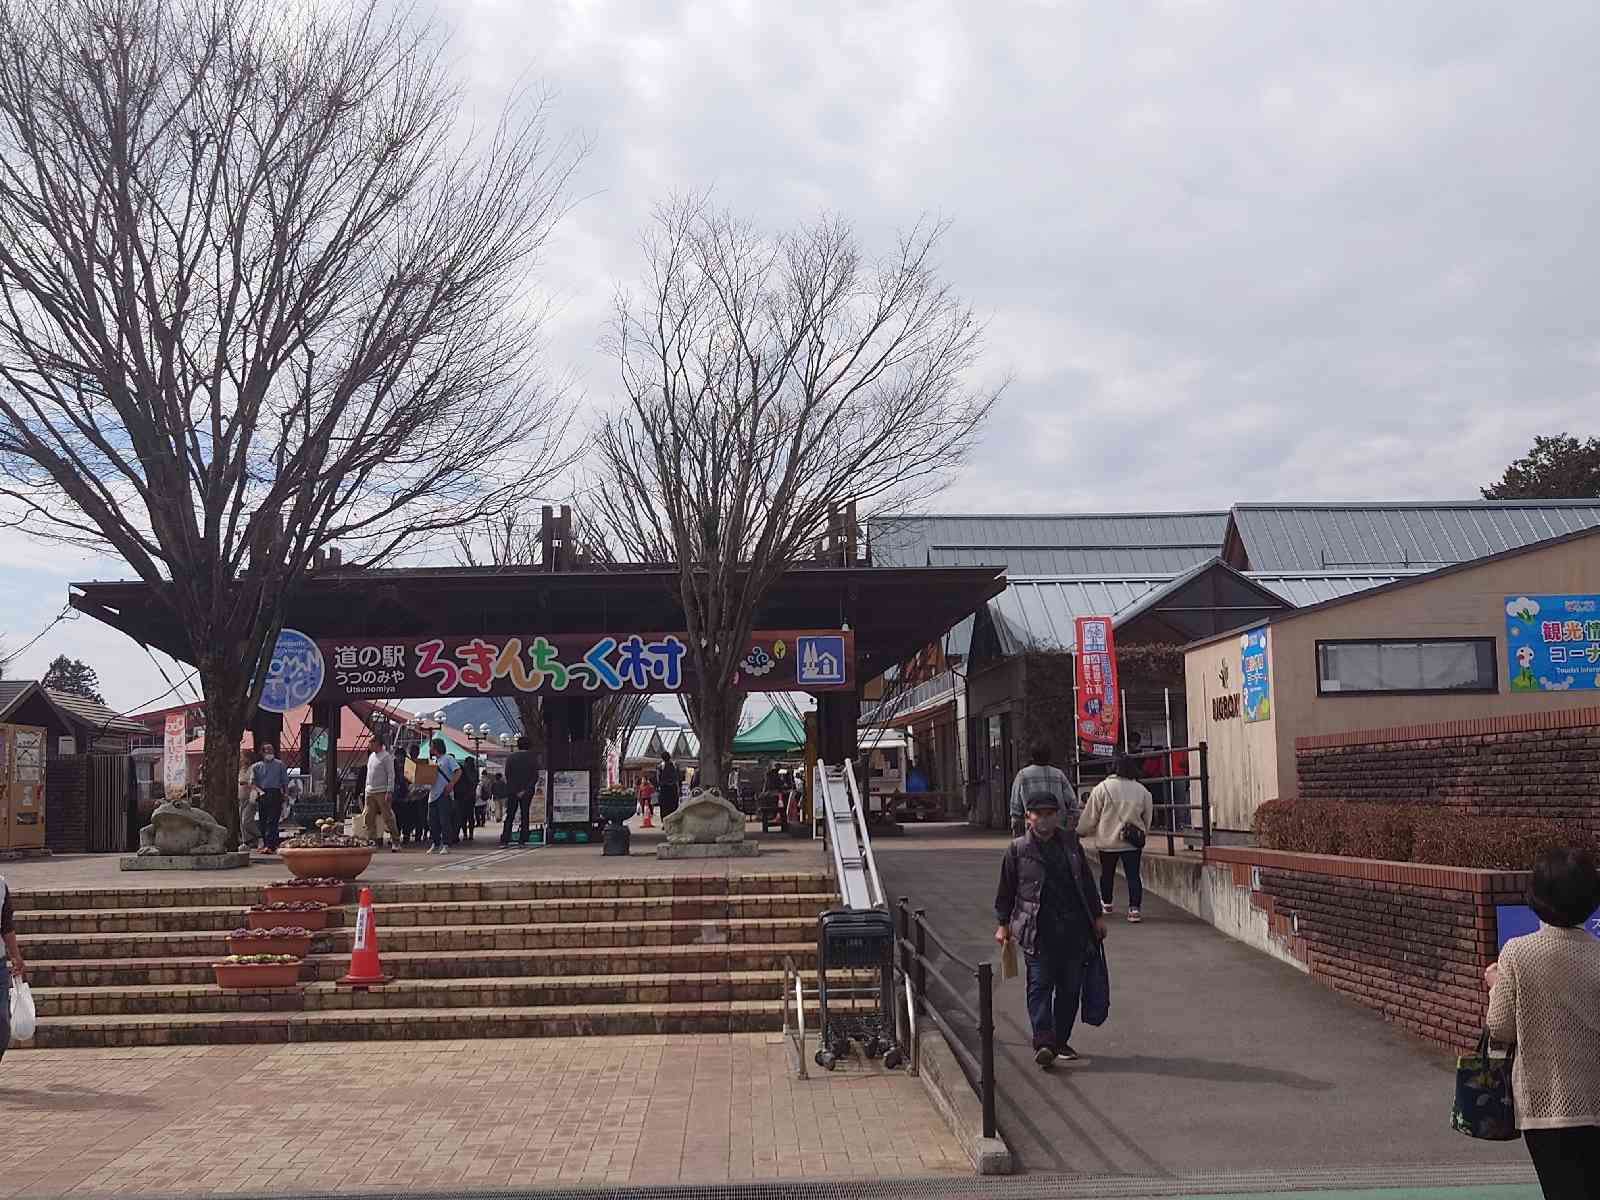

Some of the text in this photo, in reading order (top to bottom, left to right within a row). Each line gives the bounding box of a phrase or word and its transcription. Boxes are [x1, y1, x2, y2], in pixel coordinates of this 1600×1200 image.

[334, 645, 406, 669] 道の駅
[415, 634, 687, 694] ろまんちっく村
[335, 670, 406, 686] うつのみや
[345, 685, 396, 695] Utsunomiya
